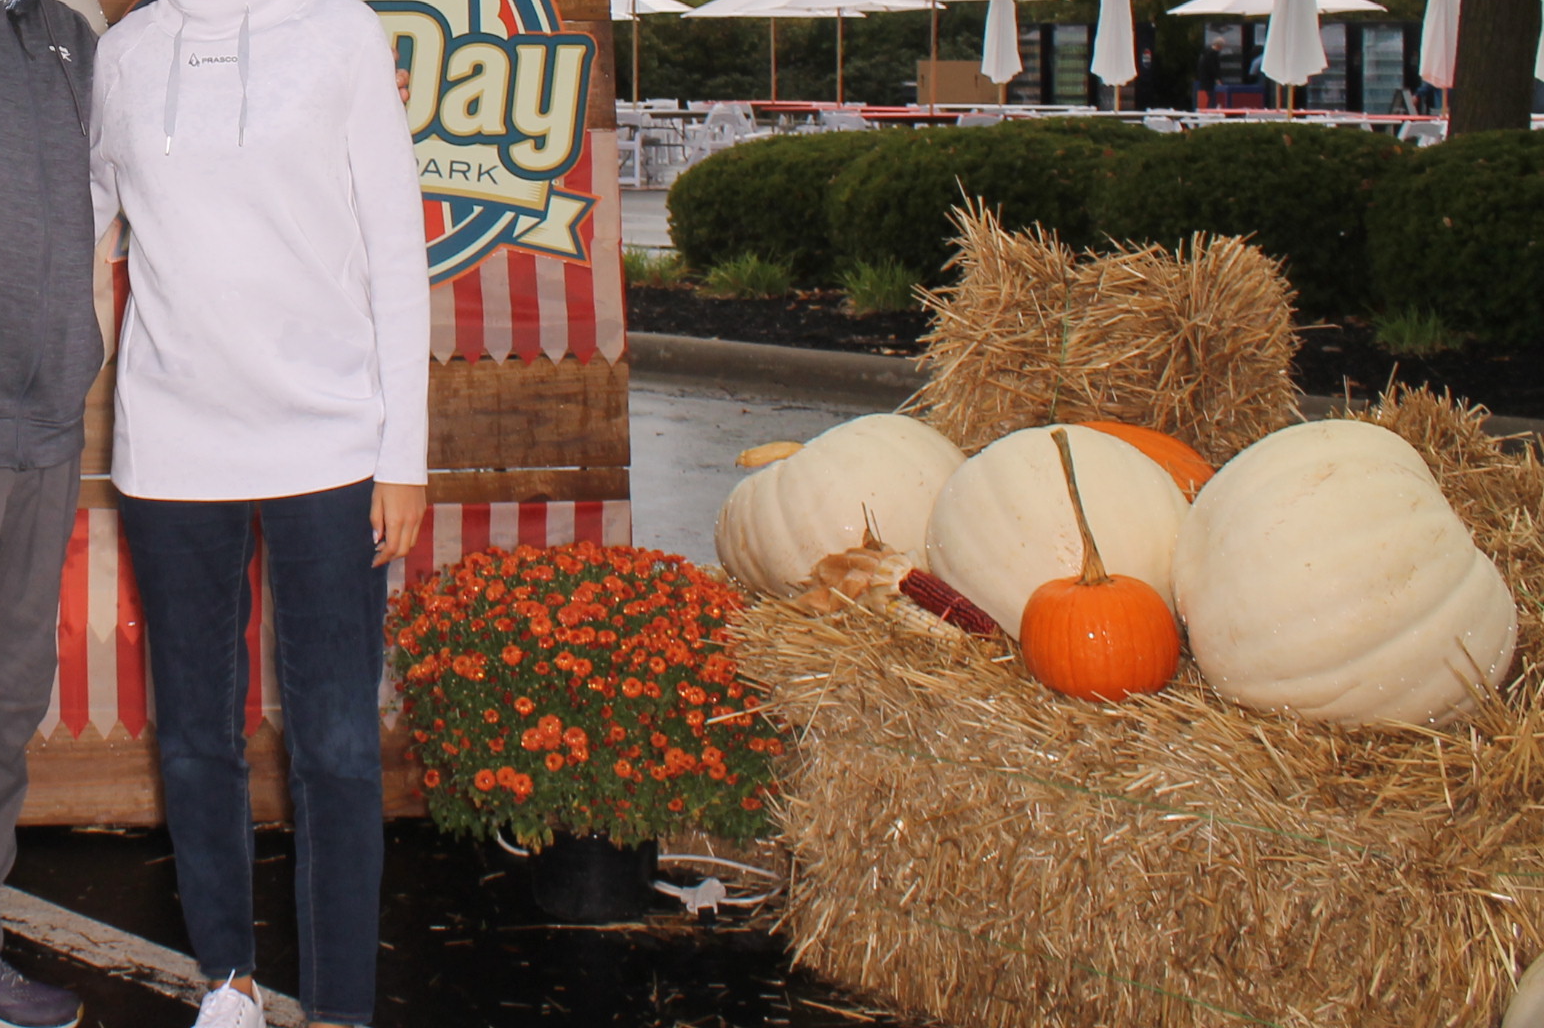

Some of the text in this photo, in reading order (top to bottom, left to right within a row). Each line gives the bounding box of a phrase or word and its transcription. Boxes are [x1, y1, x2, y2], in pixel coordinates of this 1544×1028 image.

[201, 56, 238, 64] PRASCO
[375, 9, 588, 172] Day
[416, 157, 500, 185] ARK
